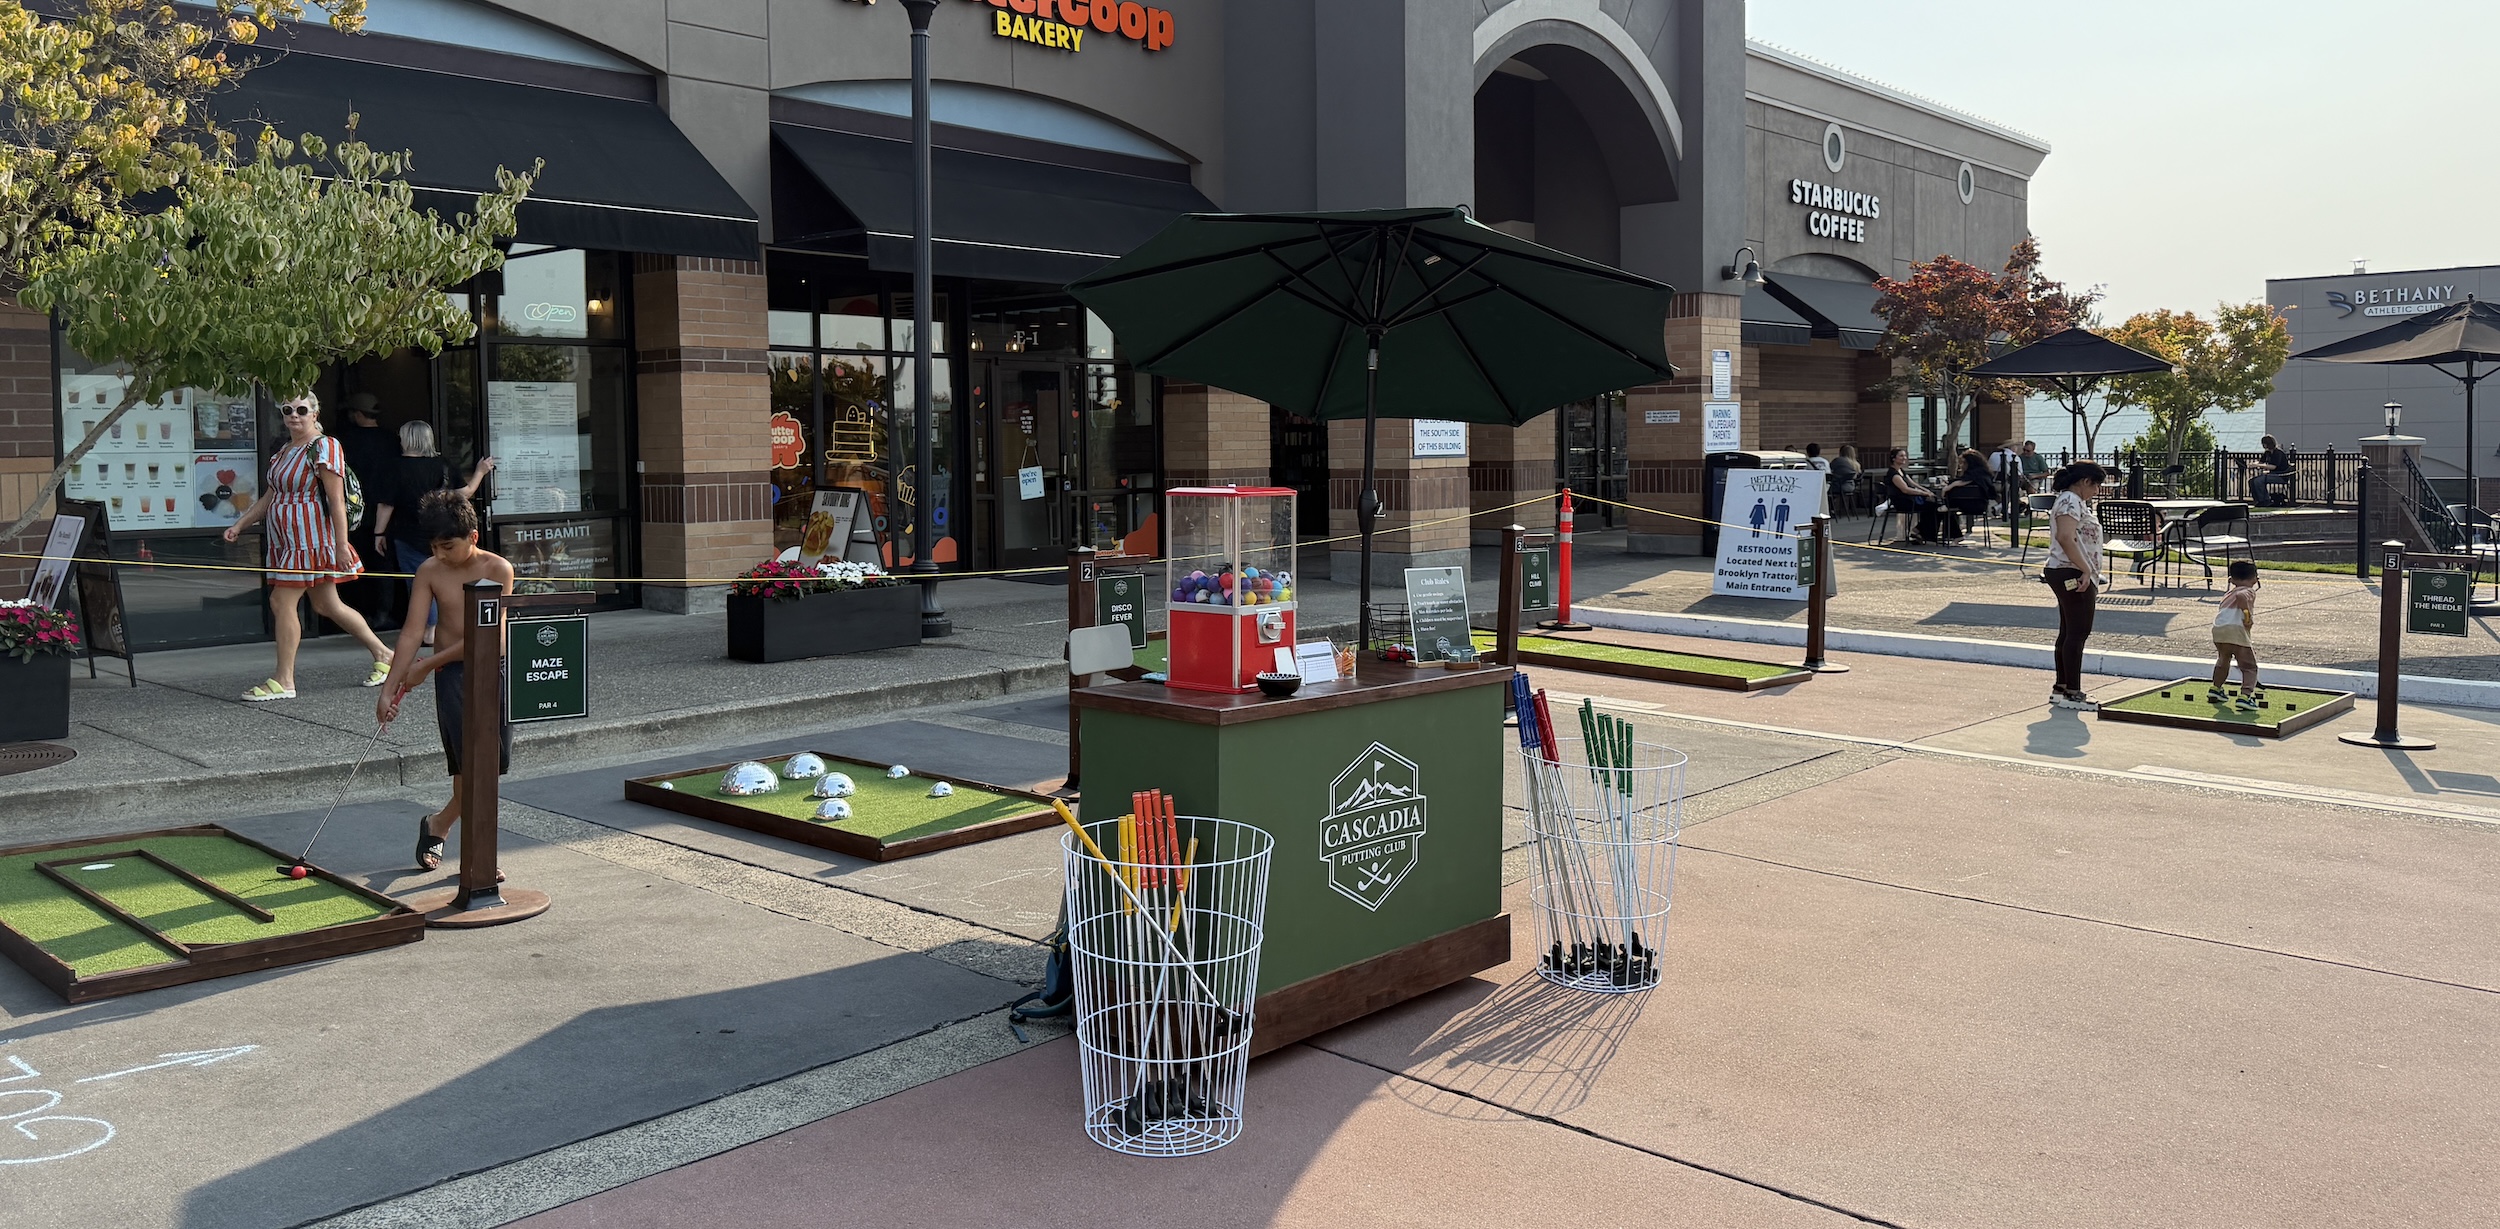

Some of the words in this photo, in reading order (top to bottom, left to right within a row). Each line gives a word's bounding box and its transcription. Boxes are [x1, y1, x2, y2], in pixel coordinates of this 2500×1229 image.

[996, 10, 1083, 52] BAKERY
[1792, 178, 1880, 219] STARBUCKS
[1809, 211, 1865, 243] COFFEE
[2355, 285, 2455, 305] BETHANY
[531, 302, 573, 321] Open
[2368, 306, 2412, 315] ATHLETIC
[1016, 330, 1039, 345] E-1
[1708, 420, 1713, 429] NO
[1715, 420, 1736, 429] LIFEGUARD
[771, 426, 794, 436] utter
[1021, 470, 1037, 478] we're
[1022, 477, 1037, 485] open
[1750, 475, 1799, 485] BETHANY
[1751, 484, 1794, 493] VILLAGE
[515, 529, 542, 542] THE
[545, 525, 590, 540] BAMITI
[1517, 542, 1522, 550] 3
[1737, 545, 1792, 555] RESTROOMS
[1727, 557, 1762, 566] Located
[1765, 559, 1788, 567] Next
[2388, 558, 2396, 568] 5
[1084, 568, 1091, 579] 2
[1718, 569, 1759, 579] Brooklyn
[1762, 571, 1798, 580] Trattori
[1420, 578, 1434, 586] Club
[1434, 577, 1449, 585] Rules
[1726, 581, 1748, 590] Main
[1751, 583, 1792, 593] Entrance
[2422, 595, 2455, 603] THREAD
[1111, 603, 1133, 612] DISCO
[2432, 603, 2463, 611] NEEDLE
[484, 607, 492, 622] 1
[1111, 612, 1133, 621] FEVER
[531, 657, 563, 669] MAZE
[526, 669, 569, 682] ESCAPE
[1324, 805, 1422, 848] CASCADIA
[1341, 846, 1382, 866] PUTTING
[1384, 840, 1406, 854] CLUB
